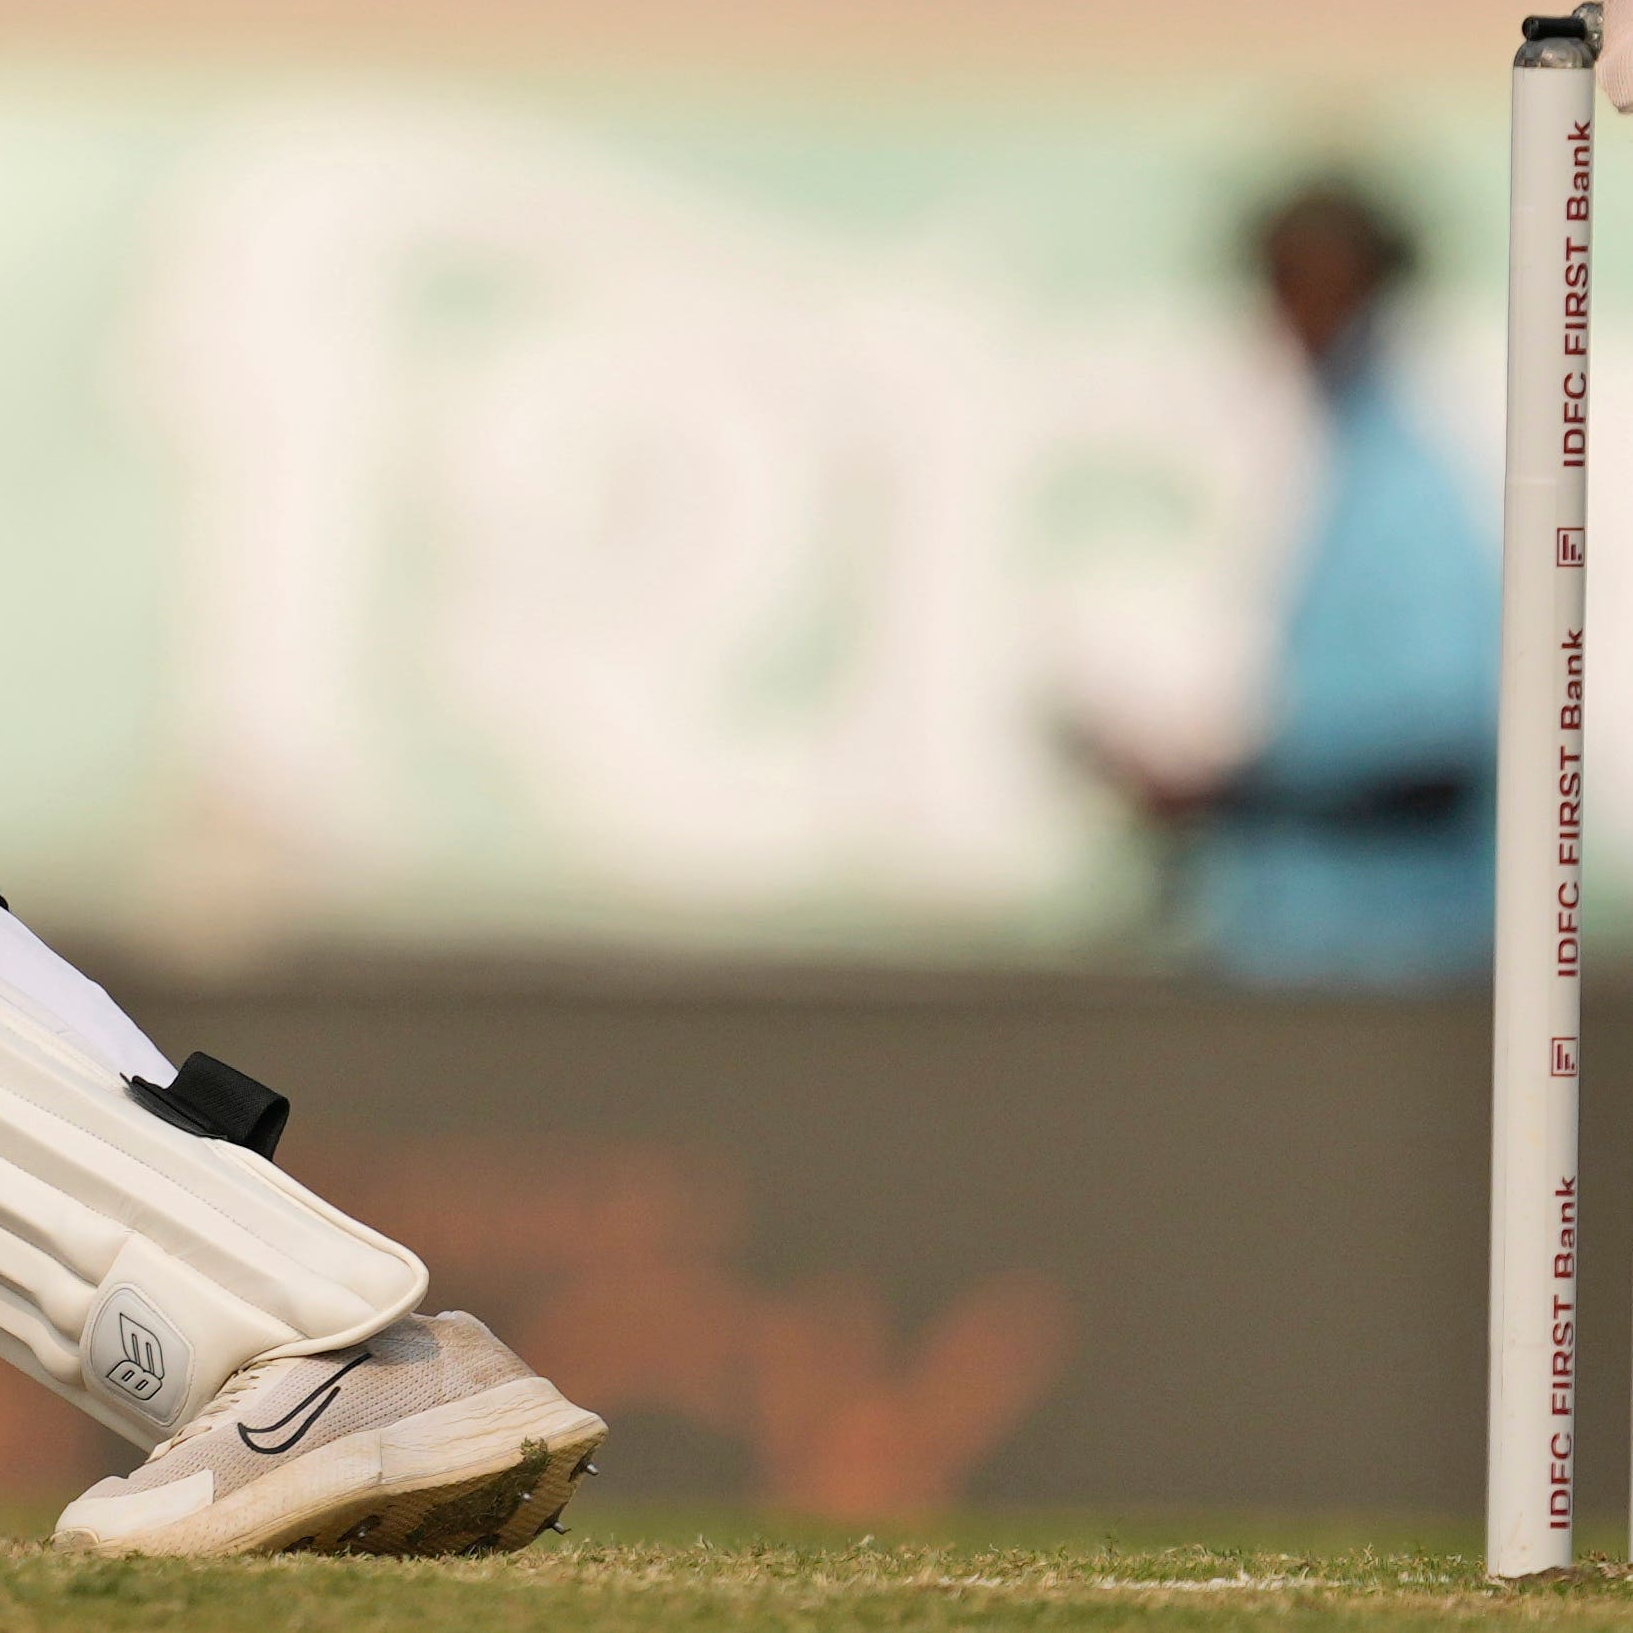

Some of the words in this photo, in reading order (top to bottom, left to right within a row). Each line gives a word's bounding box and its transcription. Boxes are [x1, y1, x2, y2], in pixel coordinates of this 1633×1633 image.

[1565, 120, 1591, 221] Bank
[1564, 236, 1589, 356] FIRST
[1563, 371, 1587, 467] IDFC
[1560, 627, 1583, 730] Bank
[1558, 745, 1582, 865] FIRST
[1557, 881, 1580, 977] IDFC
[1553, 1174, 1576, 1278] Bank
[1551, 1293, 1575, 1416] FIRST
[1549, 1432, 1572, 1530] IDFC
